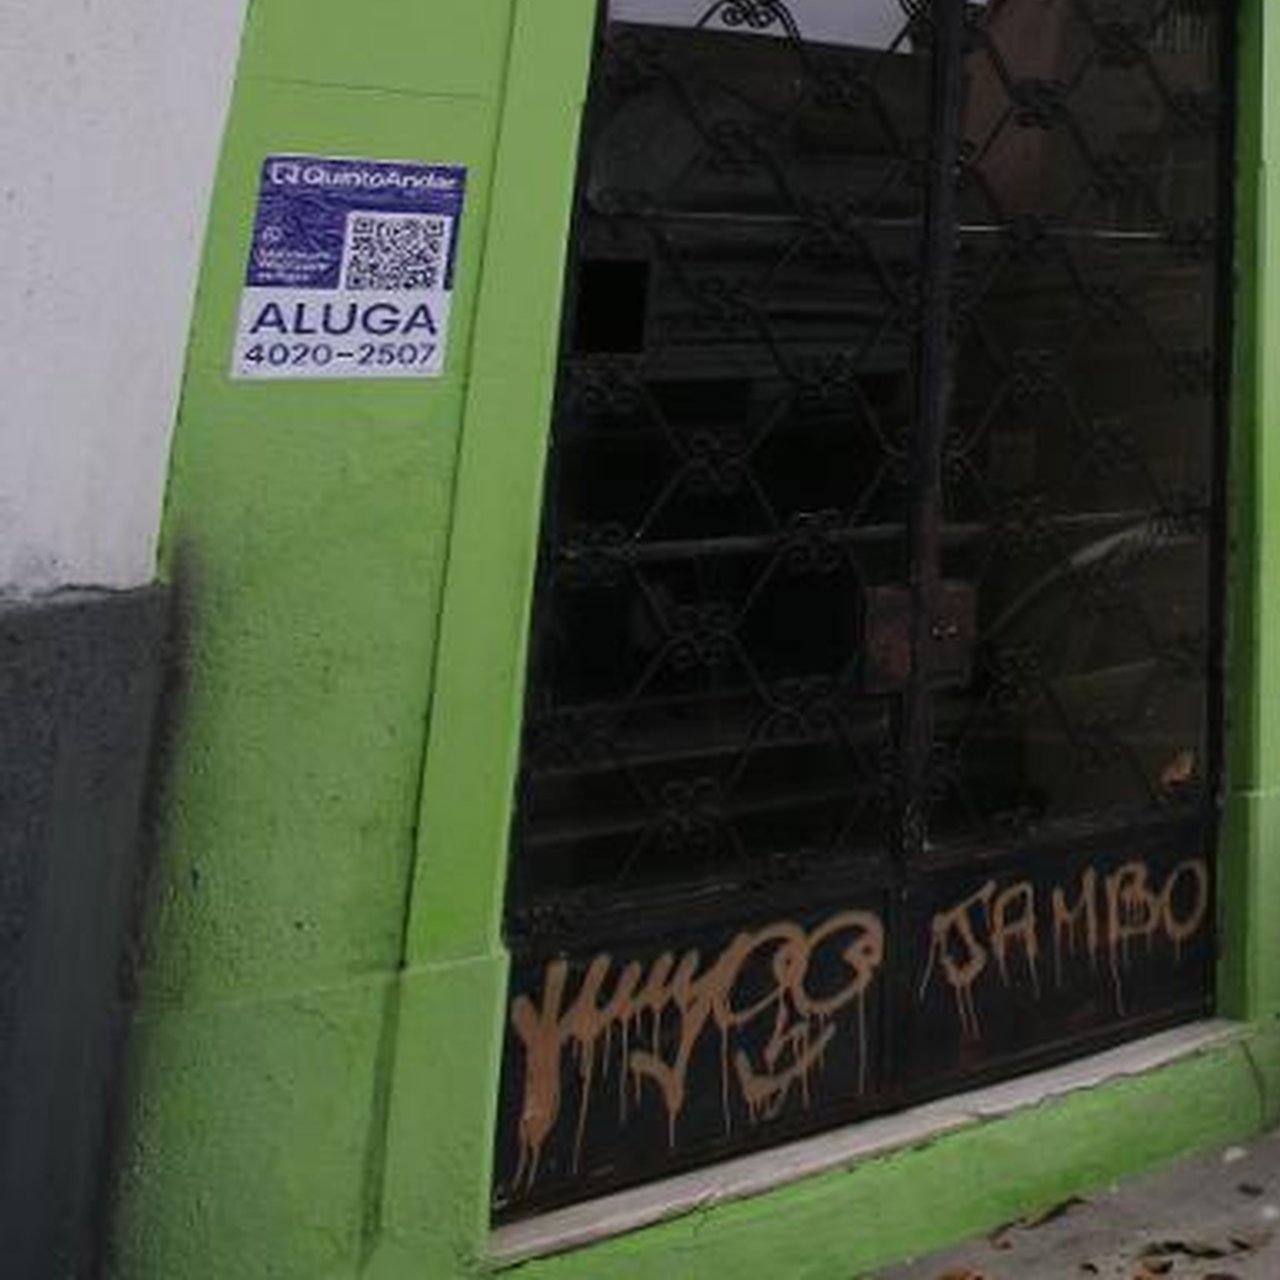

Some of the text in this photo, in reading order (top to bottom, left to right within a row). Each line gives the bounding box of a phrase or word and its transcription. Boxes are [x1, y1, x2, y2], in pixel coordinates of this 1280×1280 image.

[302, 166, 458, 189] QuintoAndar
[249, 302, 437, 335] ALUGA
[244, 342, 437, 366] 4020-2507
[925, 858, 1210, 1005] JAMBO
